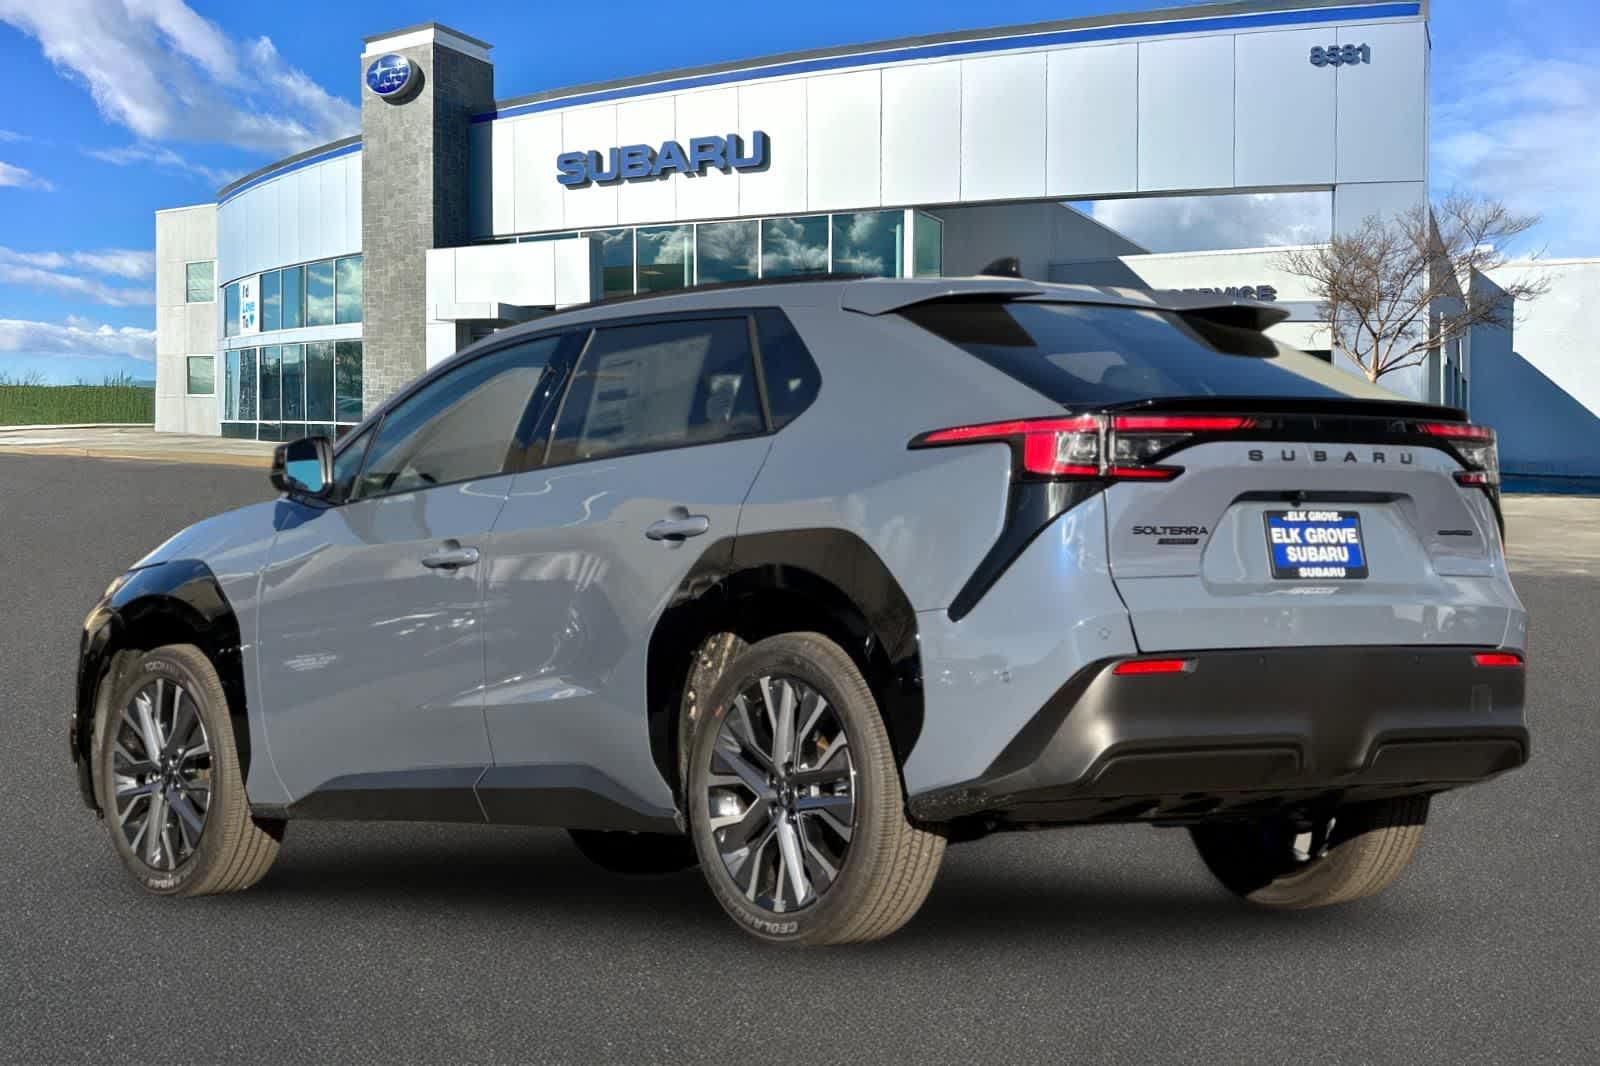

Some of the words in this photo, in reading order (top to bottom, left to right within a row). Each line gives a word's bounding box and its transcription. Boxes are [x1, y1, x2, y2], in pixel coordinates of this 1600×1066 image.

[556, 130, 771, 190] SUBARU
[1248, 449, 1414, 465] SUBARU
[1287, 511, 1306, 521] ELK
[1308, 511, 1339, 521] GROVE
[1132, 525, 1208, 535] SOLTERRA
[1271, 527, 1302, 544] ELK
[1304, 527, 1358, 544] GROVE
[1286, 545, 1349, 562] SUBARU
[1298, 567, 1346, 577] SUBARU
